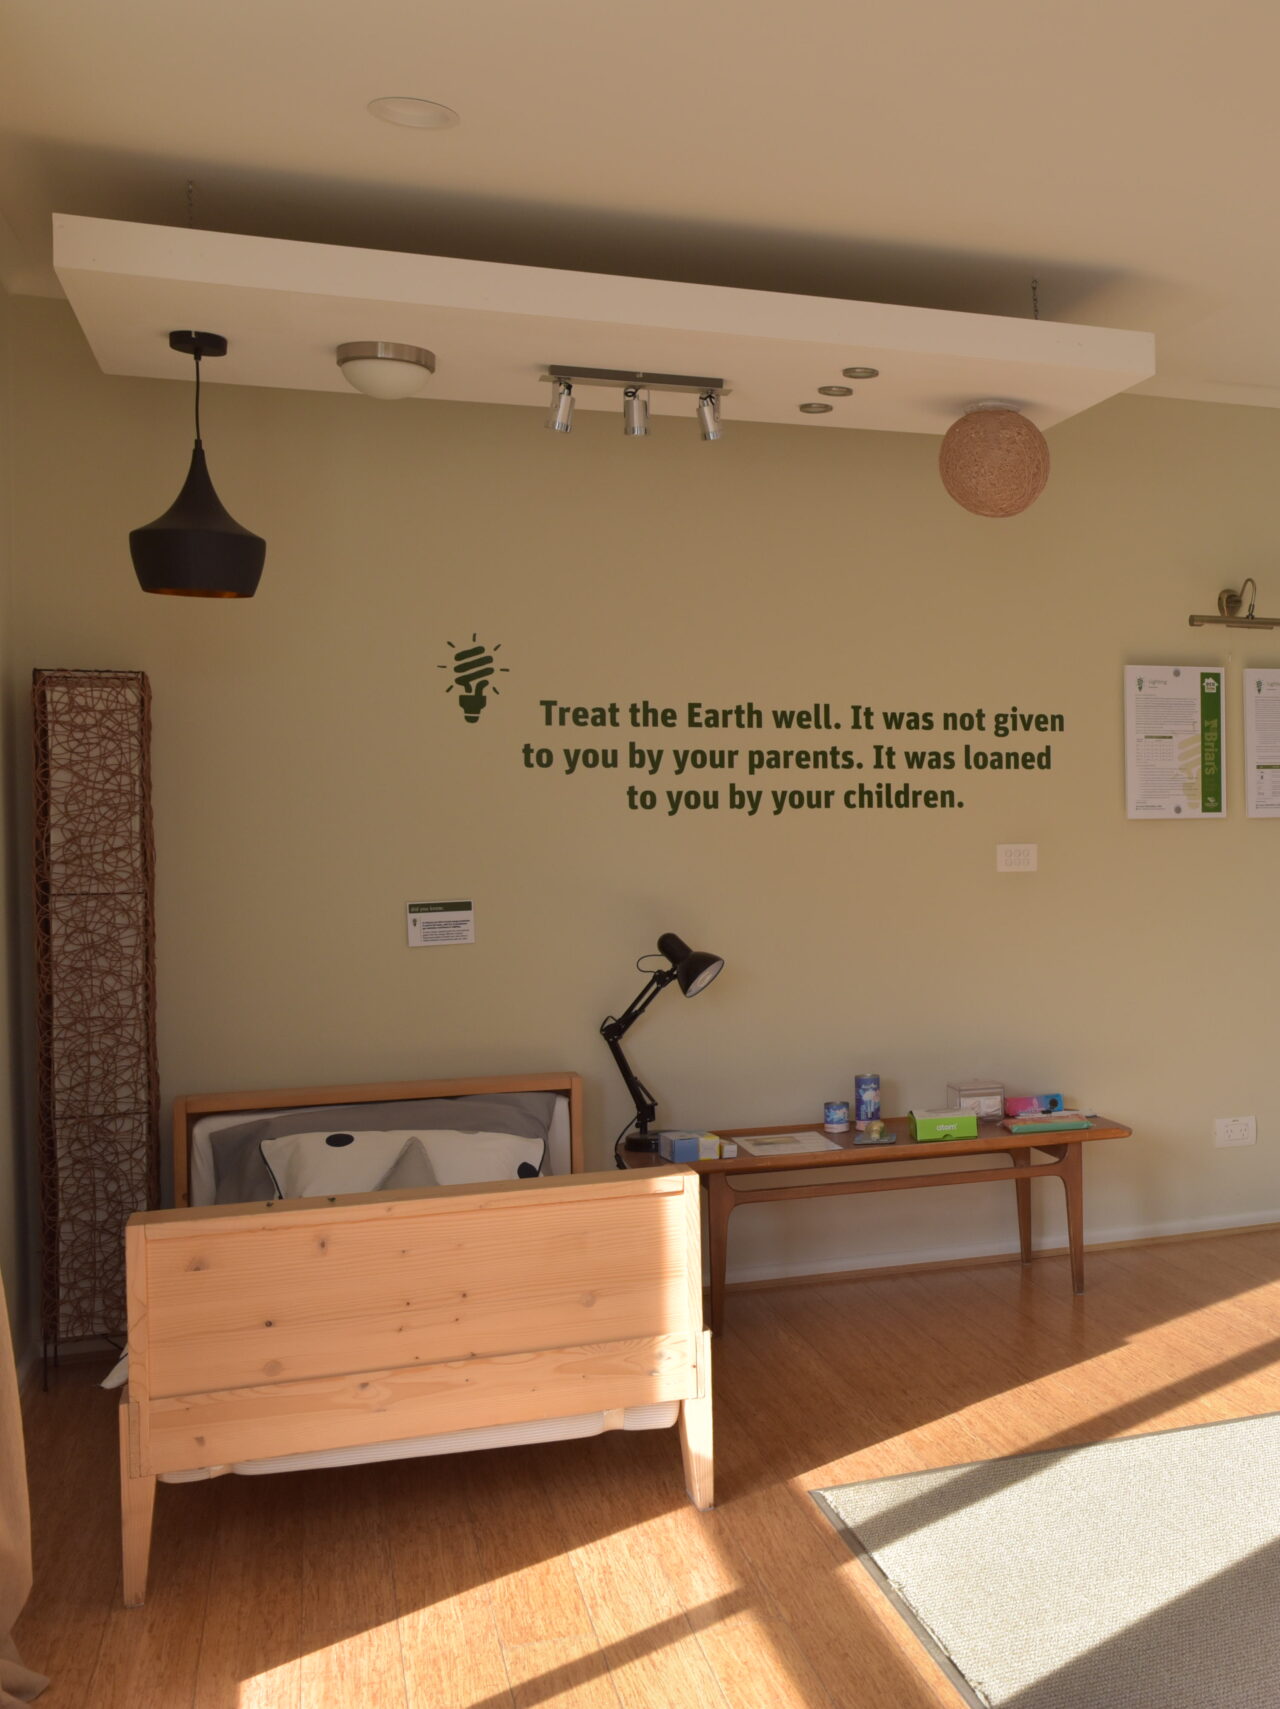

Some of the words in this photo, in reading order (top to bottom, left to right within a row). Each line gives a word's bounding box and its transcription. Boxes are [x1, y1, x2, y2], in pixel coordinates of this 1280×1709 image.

[540, 700, 619, 727] Treat
[629, 701, 677, 727] the
[688, 702, 762, 728] Earth
[772, 704, 841, 729] well.
[851, 705, 874, 730] It
[882, 712, 934, 730] was
[944, 709, 985, 731] not
[994, 706, 1064, 737] given
[522, 744, 553, 768] to
[563, 749, 618, 775] you
[629, 742, 664, 775] by
[673, 750, 739, 775] your
[749, 746, 863, 775] parents.
[873, 745, 895, 769] It
[904, 751, 955, 769] was
[965, 745, 1051, 769] loaned
[627, 786, 656, 810] to
[666, 790, 718, 816] you
[730, 783, 762, 816] by
[771, 790, 835, 815] your
[844, 783, 963, 808] children.
